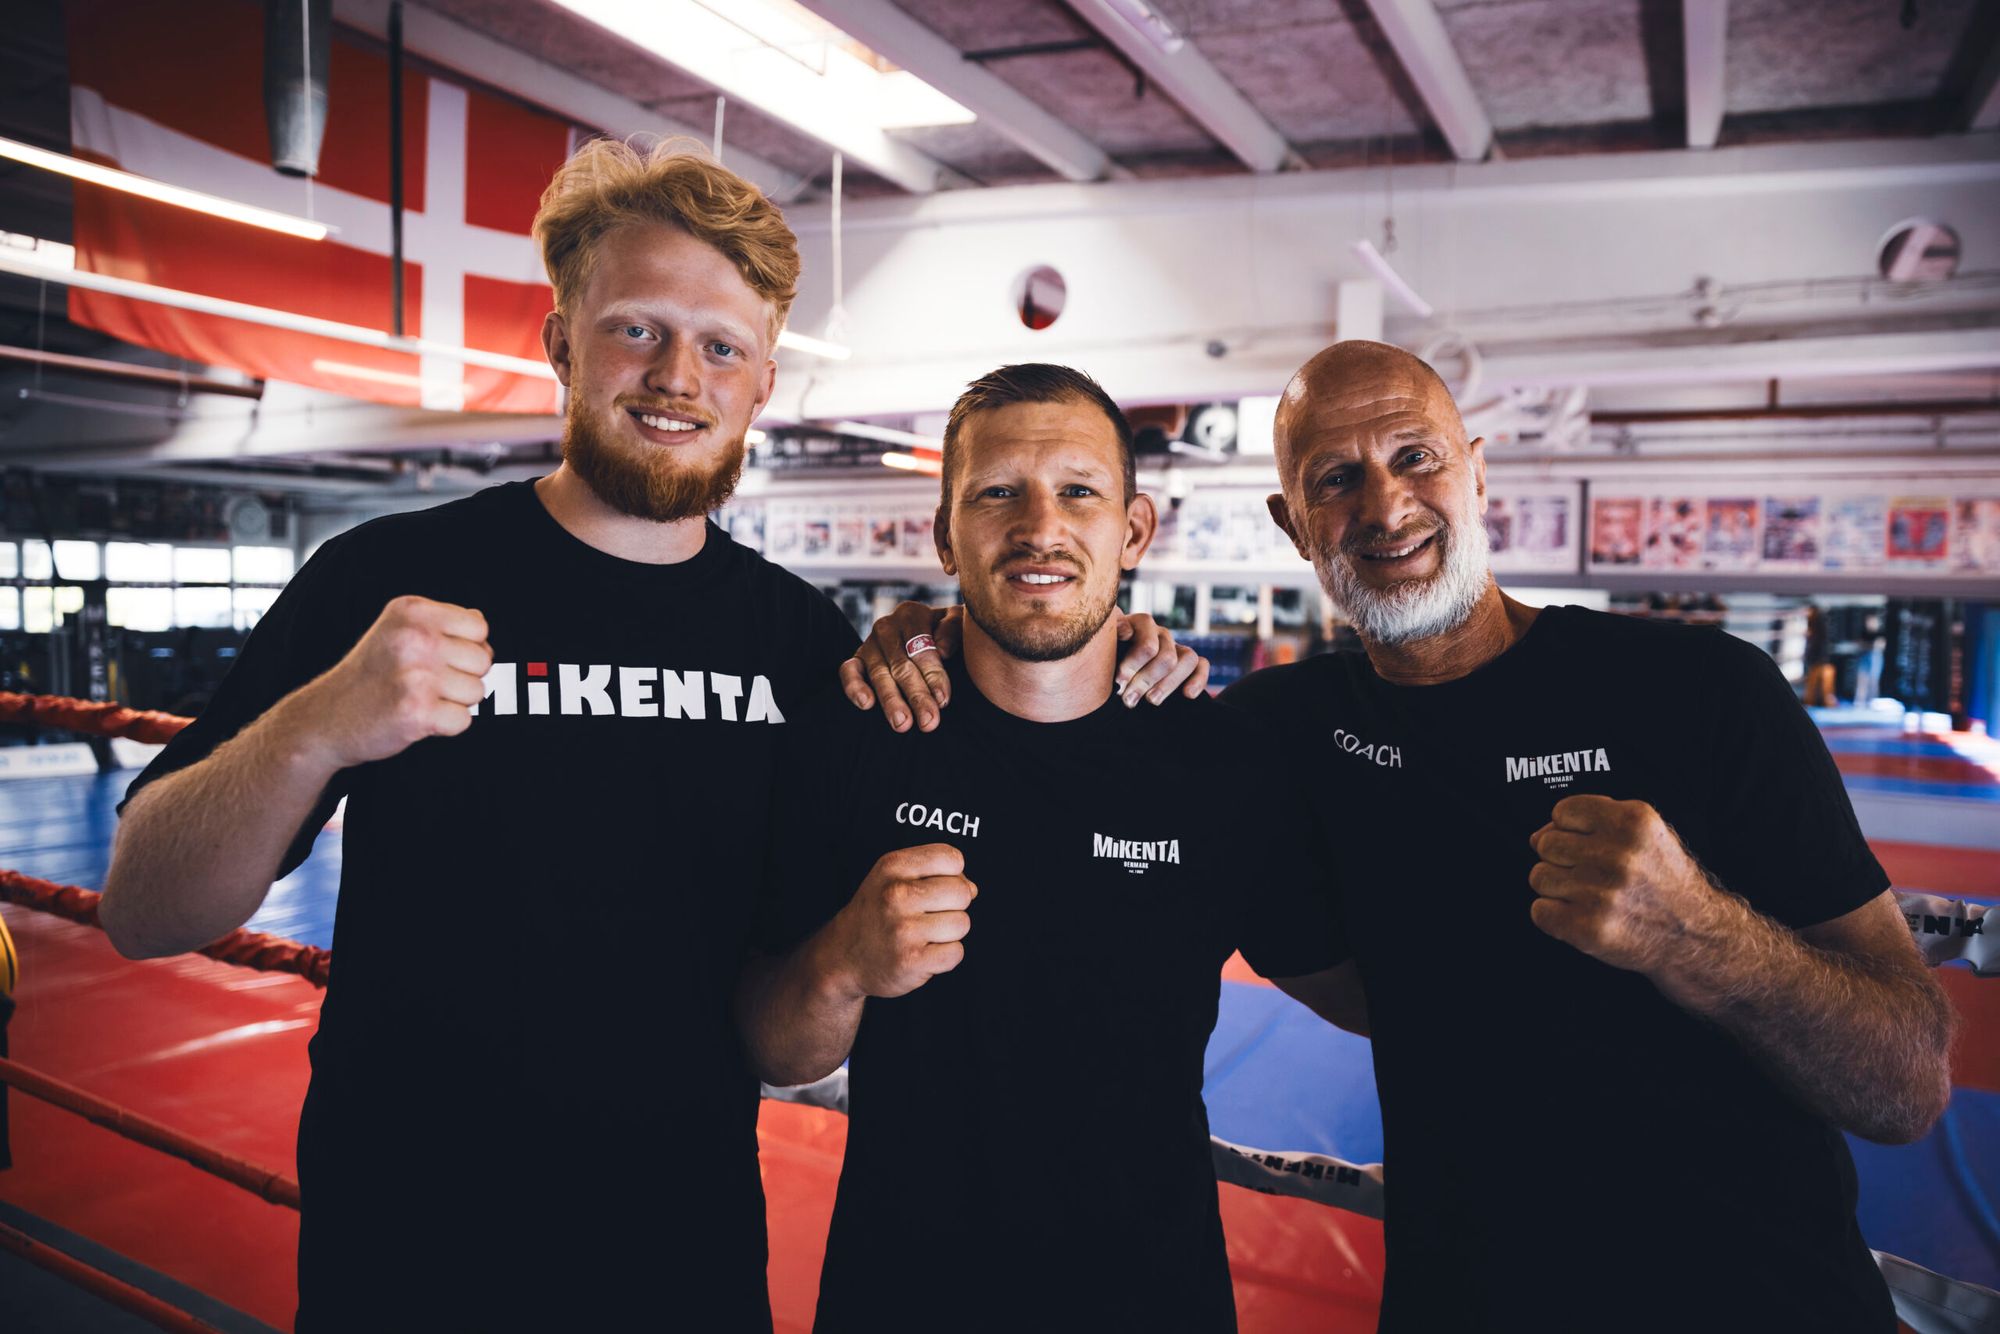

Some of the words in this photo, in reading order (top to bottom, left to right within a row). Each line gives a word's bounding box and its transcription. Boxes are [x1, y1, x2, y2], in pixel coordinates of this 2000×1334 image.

[1333, 729, 1401, 768] COACH
[1543, 775, 1573, 784] DENMARK
[895, 802, 980, 837] COACH
